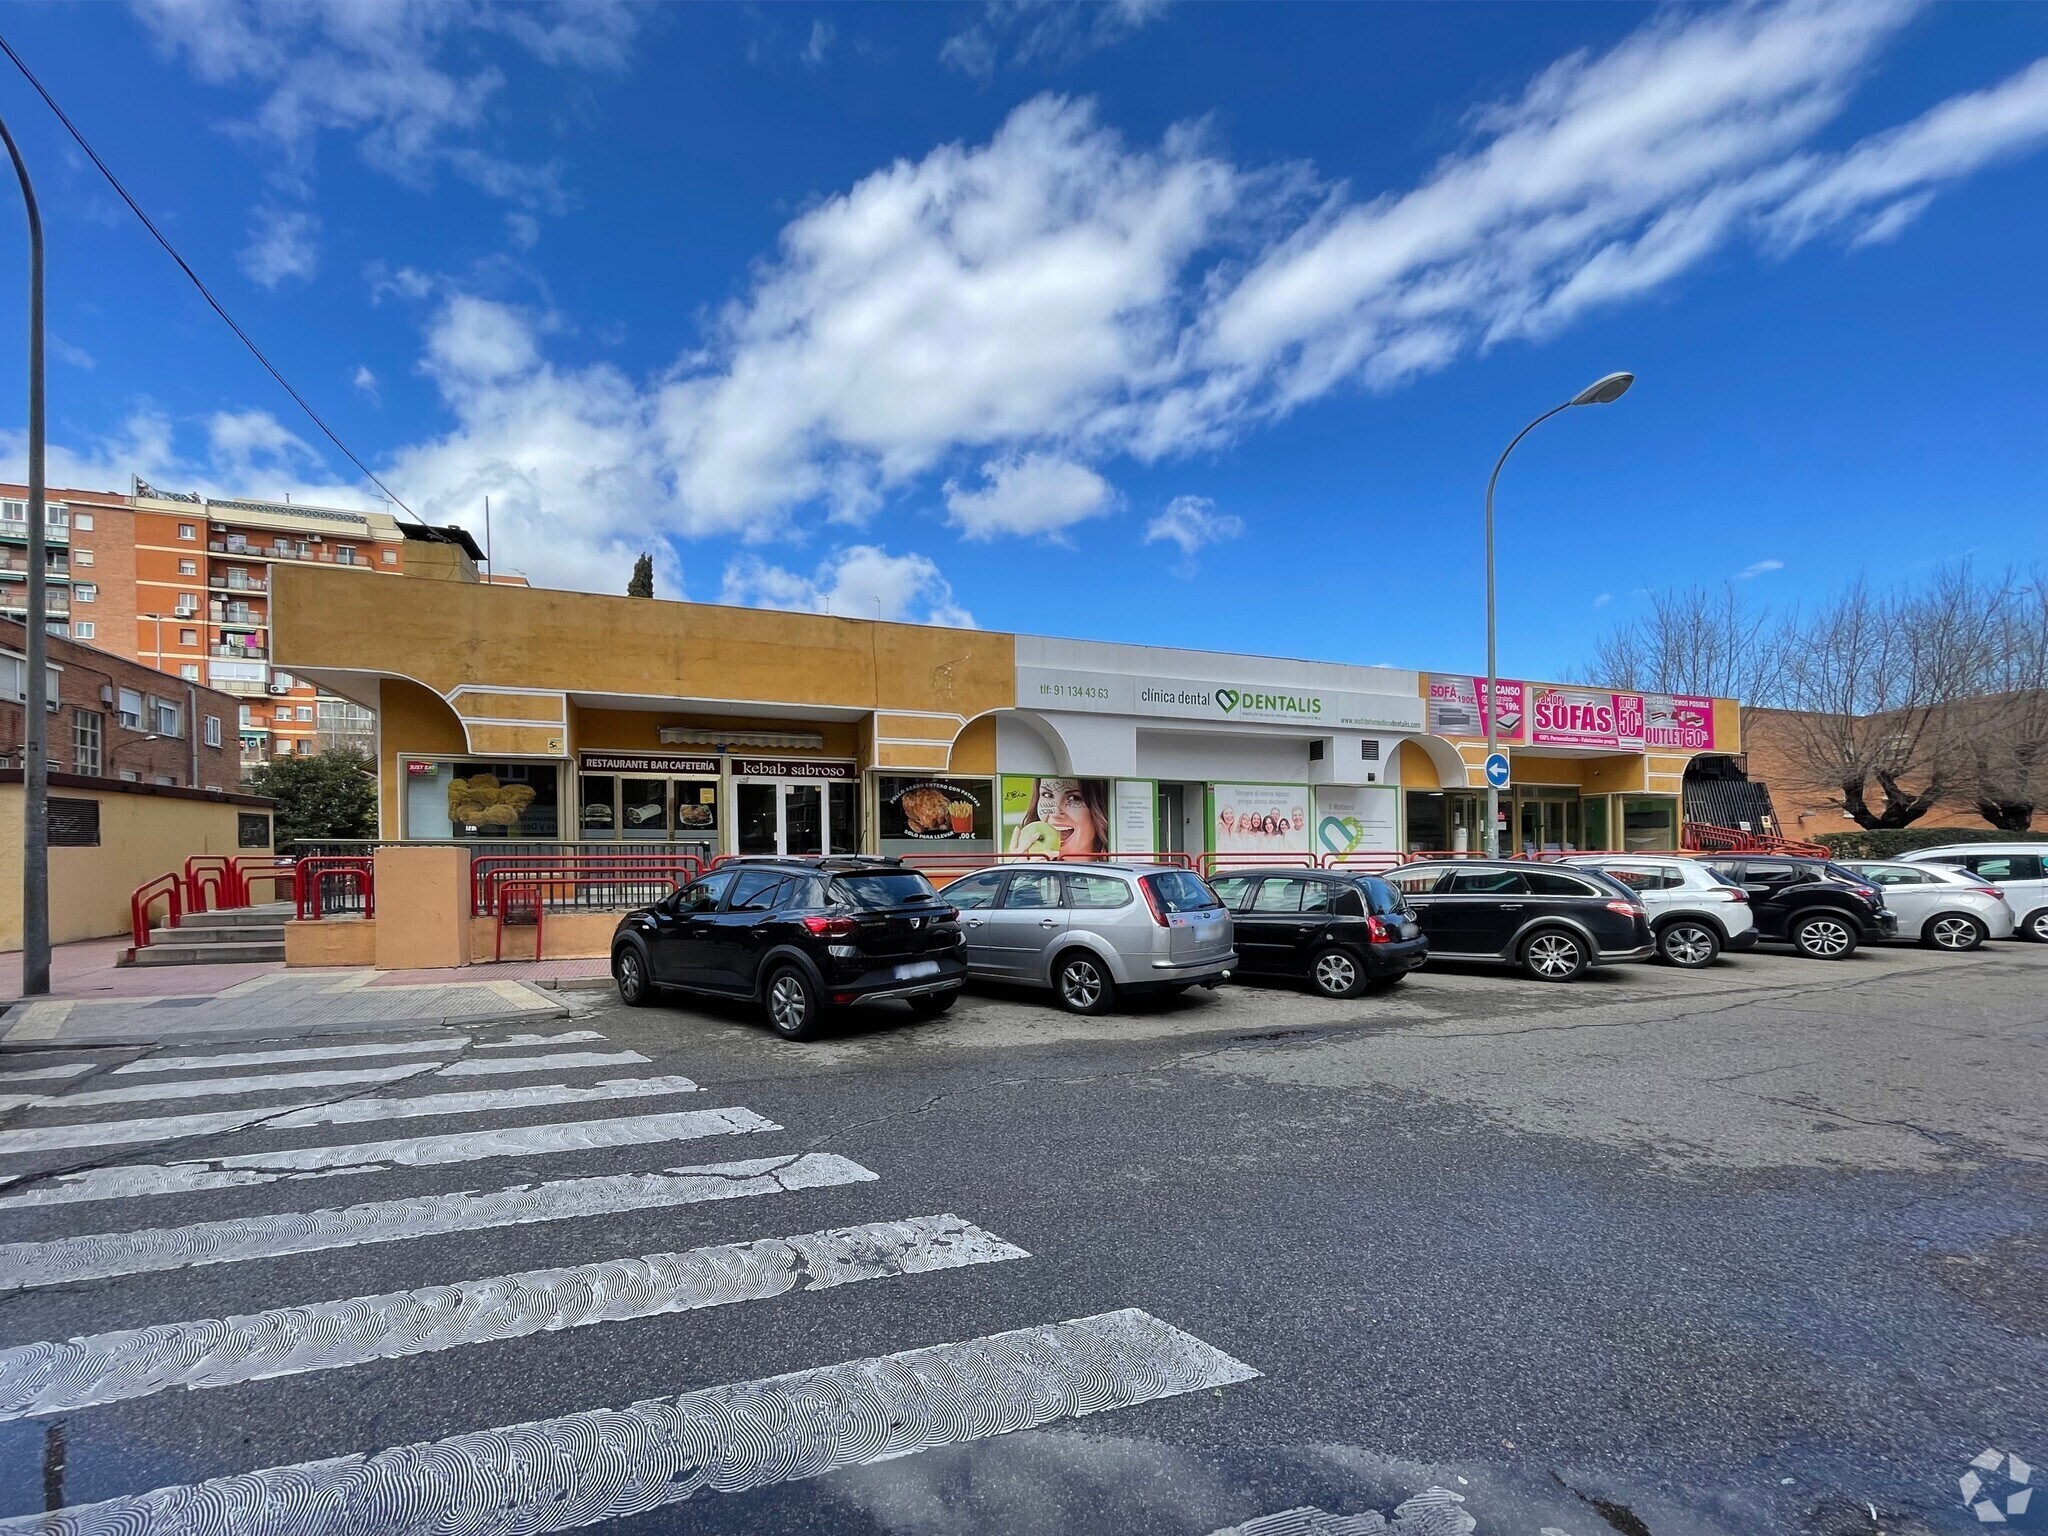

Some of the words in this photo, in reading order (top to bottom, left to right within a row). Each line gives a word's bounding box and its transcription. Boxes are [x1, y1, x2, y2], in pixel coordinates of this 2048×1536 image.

[1040, 684, 1052, 695] tlf:
[1054, 685, 1064, 696] 91
[1068, 686, 1083, 697] 134
[1085, 687, 1096, 698] 43
[1098, 688, 1109, 699] 63
[1141, 688, 1175, 704] clínica
[1178, 690, 1210, 706] dental
[1430, 684, 1457, 698] SOFÁ
[1481, 684, 1520, 696] DCANSO
[1242, 693, 1321, 714] DENTALIS
[1619, 696, 1639, 709] OUTLET
[1644, 697, 1655, 705] ODO
[1535, 700, 1612, 734] SOFÁS
[1645, 727, 1684, 747] OUTLET
[586, 758, 649, 769] RESTAURANTE
[650, 760, 668, 770] BAR
[669, 760, 715, 771] CAFETERÍA
[742, 762, 787, 775] kebab
[791, 764, 845, 776] sabroso
[889, 788, 905, 804] POLLO
[905, 783, 924, 792] ASADO
[948, 785, 961, 793] CON
[961, 788, 981, 807] PATATAS
[904, 829, 918, 838] SOLO
[934, 831, 955, 840] LLEVAR
